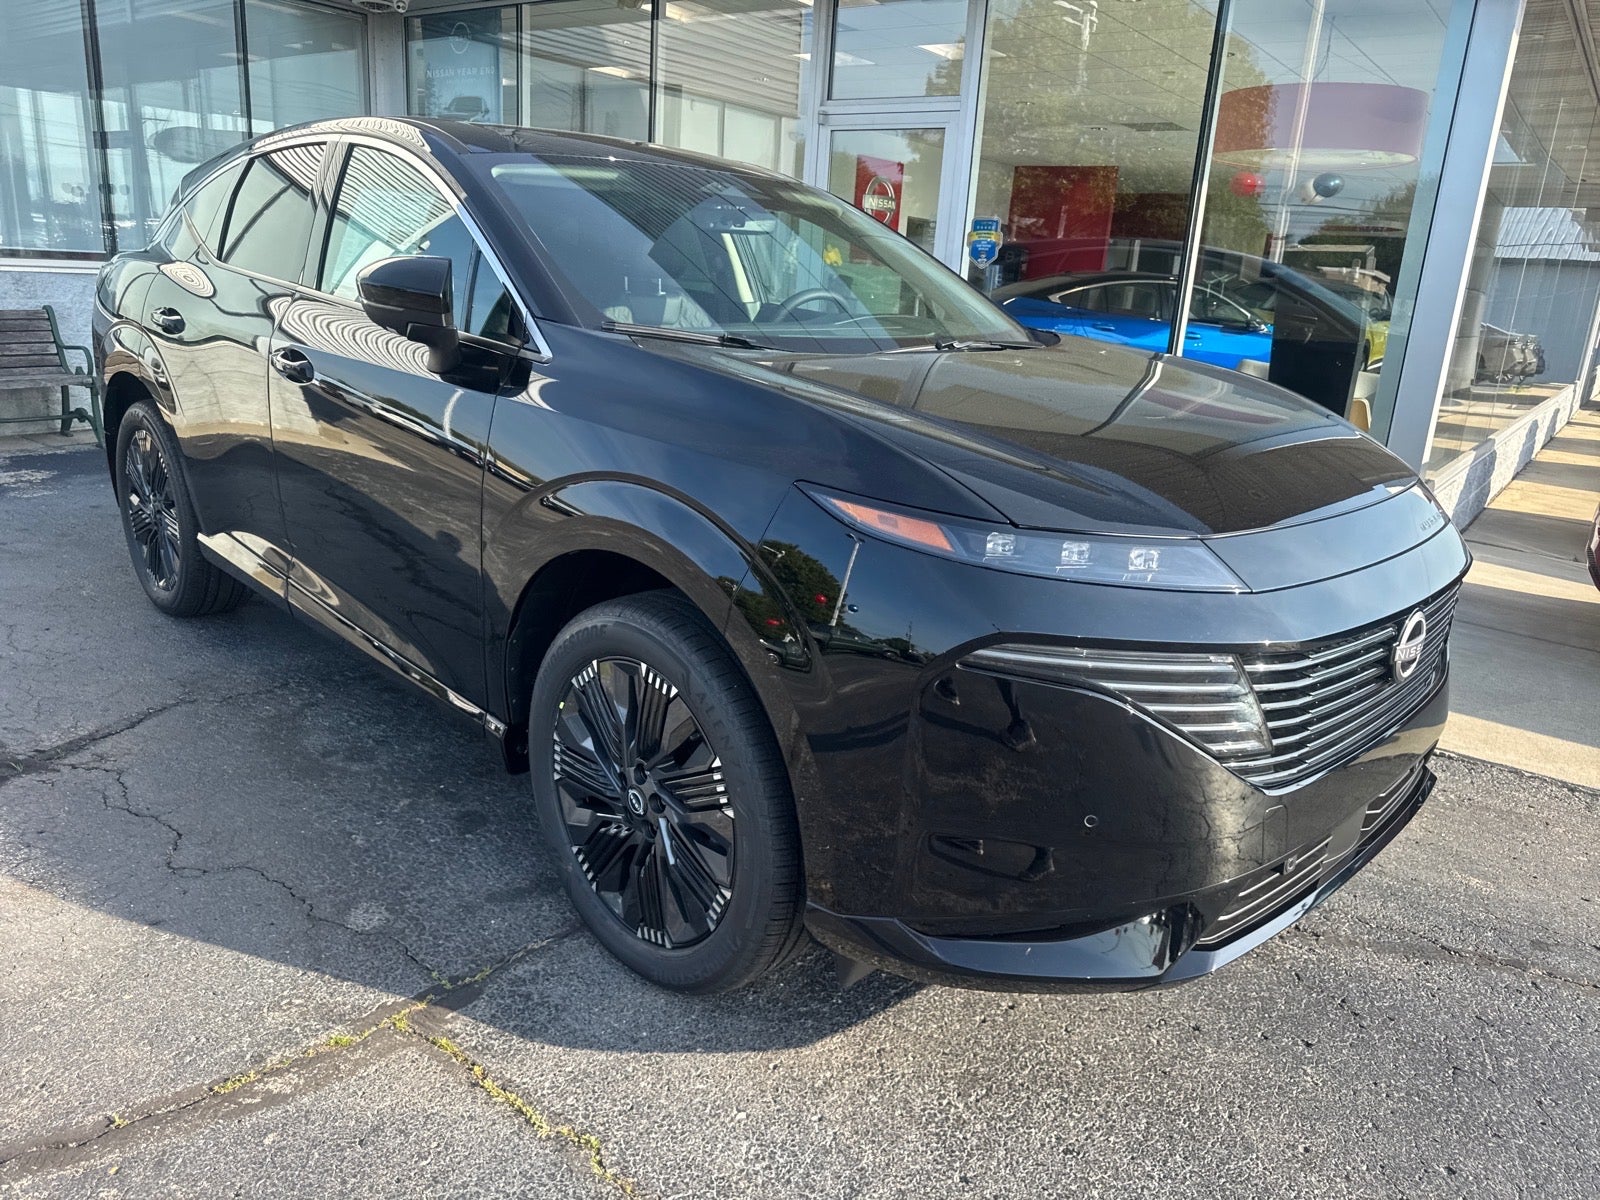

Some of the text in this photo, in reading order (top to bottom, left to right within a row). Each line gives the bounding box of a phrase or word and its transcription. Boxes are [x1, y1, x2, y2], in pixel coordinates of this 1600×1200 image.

[426, 66, 495, 78] NISSAN YEAR END
[869, 197, 896, 210] NISSAN
[1396, 643, 1423, 660] NISS
